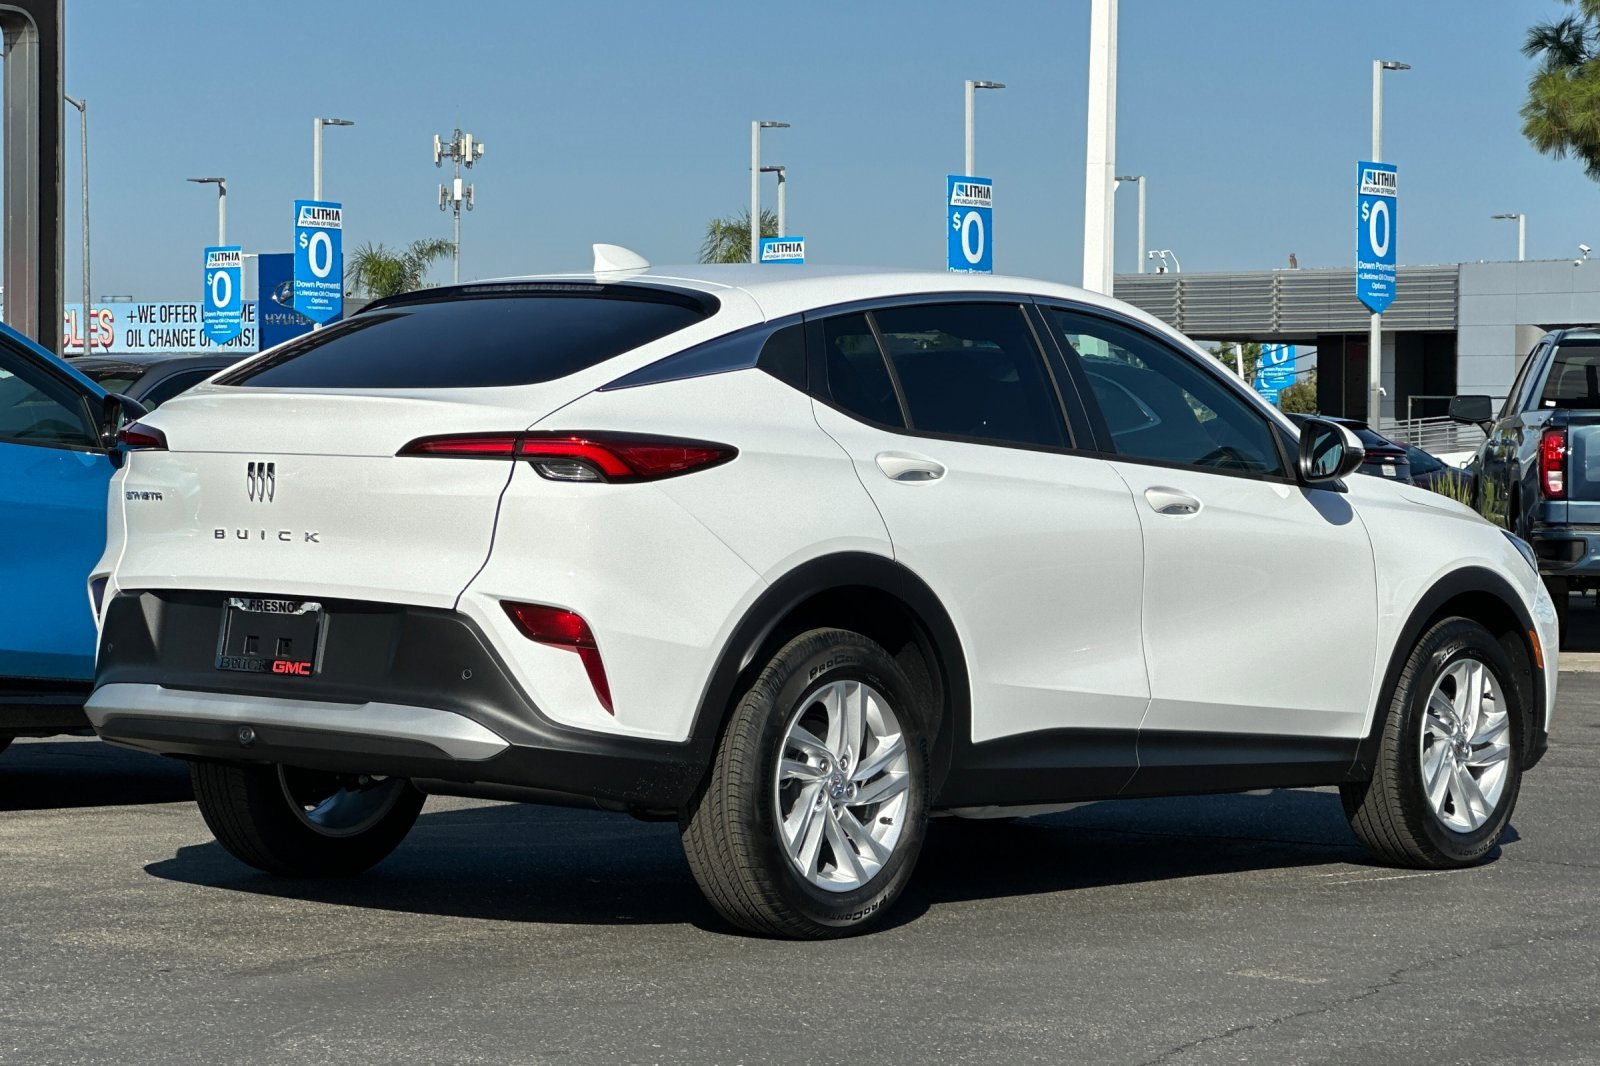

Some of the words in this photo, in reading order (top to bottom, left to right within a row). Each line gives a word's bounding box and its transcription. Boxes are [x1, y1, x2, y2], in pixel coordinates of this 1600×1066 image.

[1373, 171, 1396, 188] LITHIA
[965, 184, 992, 199] LITHIA
[312, 208, 341, 221] LITHIA
[1362, 200, 1390, 257] $0
[953, 211, 985, 264] $0
[300, 231, 333, 278] $0
[773, 242, 803, 253] LITHIA
[214, 252, 240, 262] LITHIA
[1358, 260, 1376, 270] Down
[207, 270, 232, 309] $0
[296, 280, 315, 288] Down
[315, 281, 341, 290] Payment!
[160, 304, 197, 323] OFFER
[265, 313, 313, 326] HYUND
[126, 329, 144, 348] OIL
[148, 329, 196, 348] CHANGE
[214, 529, 320, 543] BUICK
[249, 600, 295, 613] FRESNO
[272, 660, 312, 675] GMC
